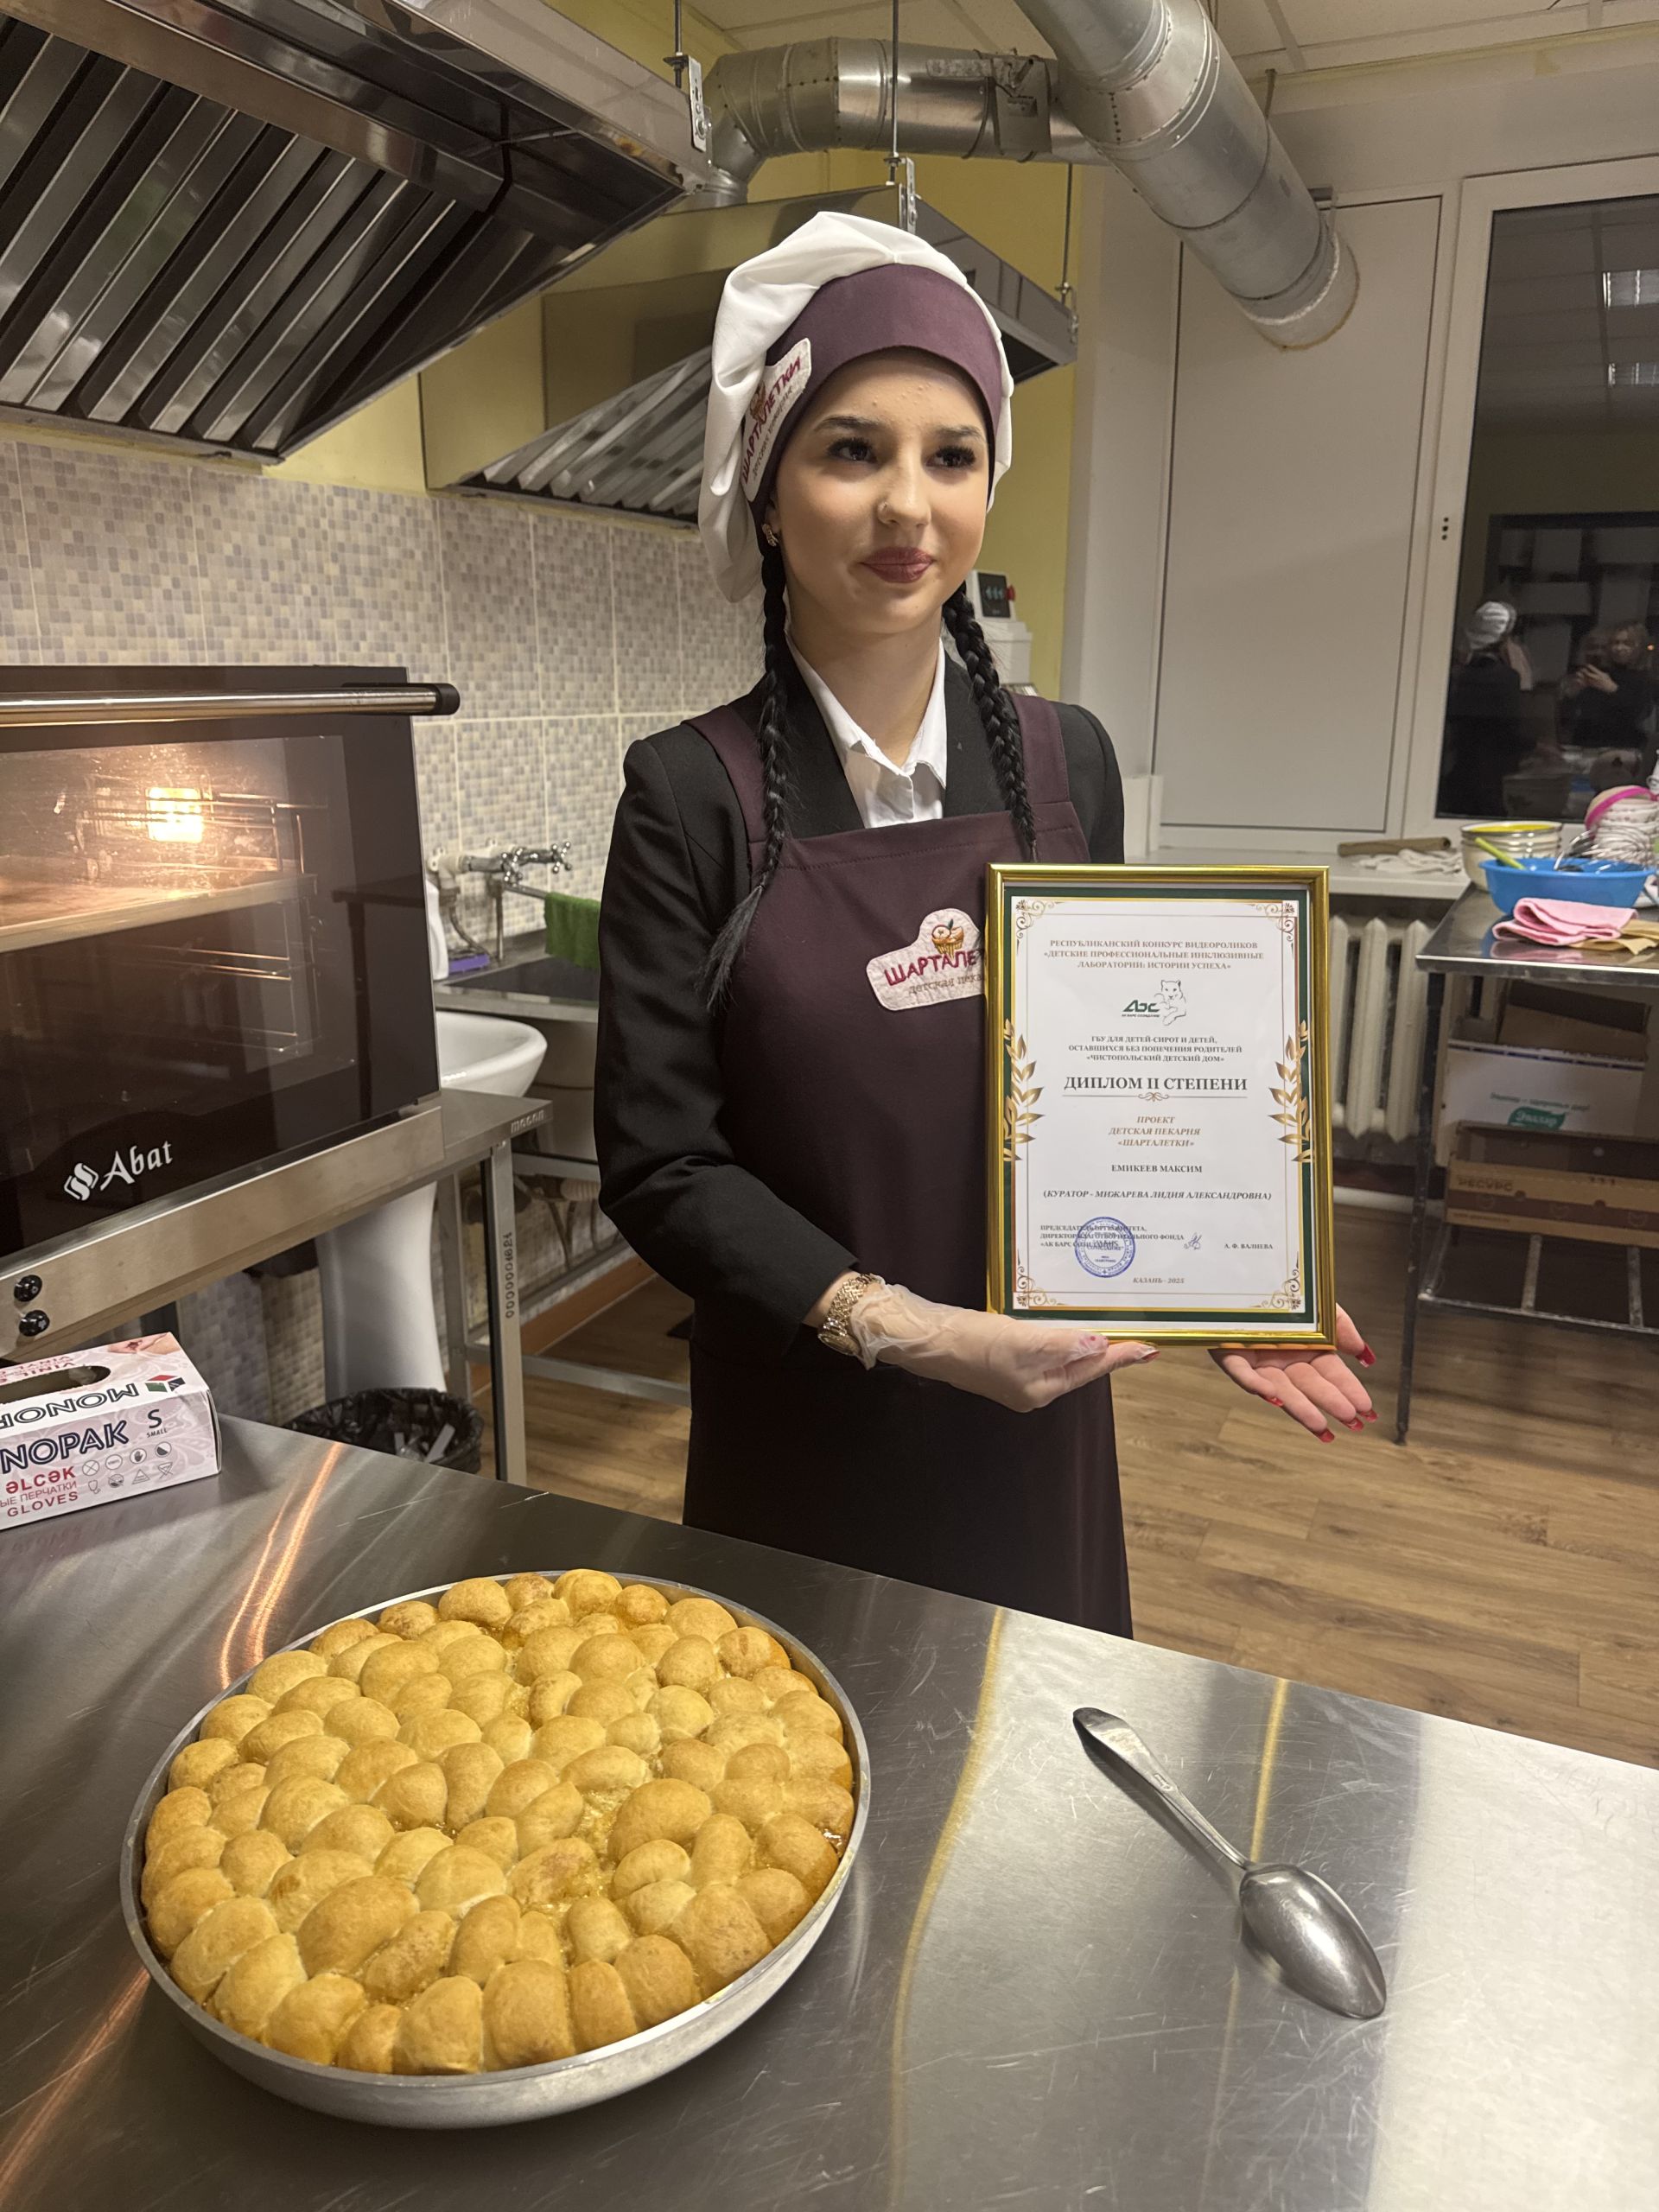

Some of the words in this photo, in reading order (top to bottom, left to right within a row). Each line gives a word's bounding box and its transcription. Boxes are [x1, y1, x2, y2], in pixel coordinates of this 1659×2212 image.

[741, 355, 801, 485] ШАРТАЛЕТКИ
[1050, 939, 1141, 948] РЕСПУБЛИКАНСКИЙ
[1185, 941, 1258, 950] ВИДЕОРОЛИКОВ
[1090, 950, 1189, 959] ПРОФЕССИОНАЛЬНЫЕ
[884, 950, 977, 987] ШАРТАЛЕ
[1064, 1077, 1142, 1090] ДИПЛОМ
[1163, 1077, 1248, 1090] СТЕПЕНИ
[1136, 1116, 1176, 1124] ПРОЕКТ
[1108, 1127, 1153, 1135] ДЕТСКАЯ
[99, 1141, 173, 1191] Abat
[1111, 1164, 1158, 1173] ЕМИКЕЕВ
[1160, 1165, 1203, 1173] МАКСИМ
[1043, 1190, 1090, 1198] (КУРАТОР
[1186, 1192, 1273, 1201] АЛЕКСАНДРОВНА)
[146, 1427, 168, 1439] SMALL
[0, 1420, 130, 1475] NOPAK
[146, 1408, 163, 1430] S
[20, 1480, 77, 1503] ПЕРЧАТКИ
[7, 1491, 79, 1517] GLOVES
